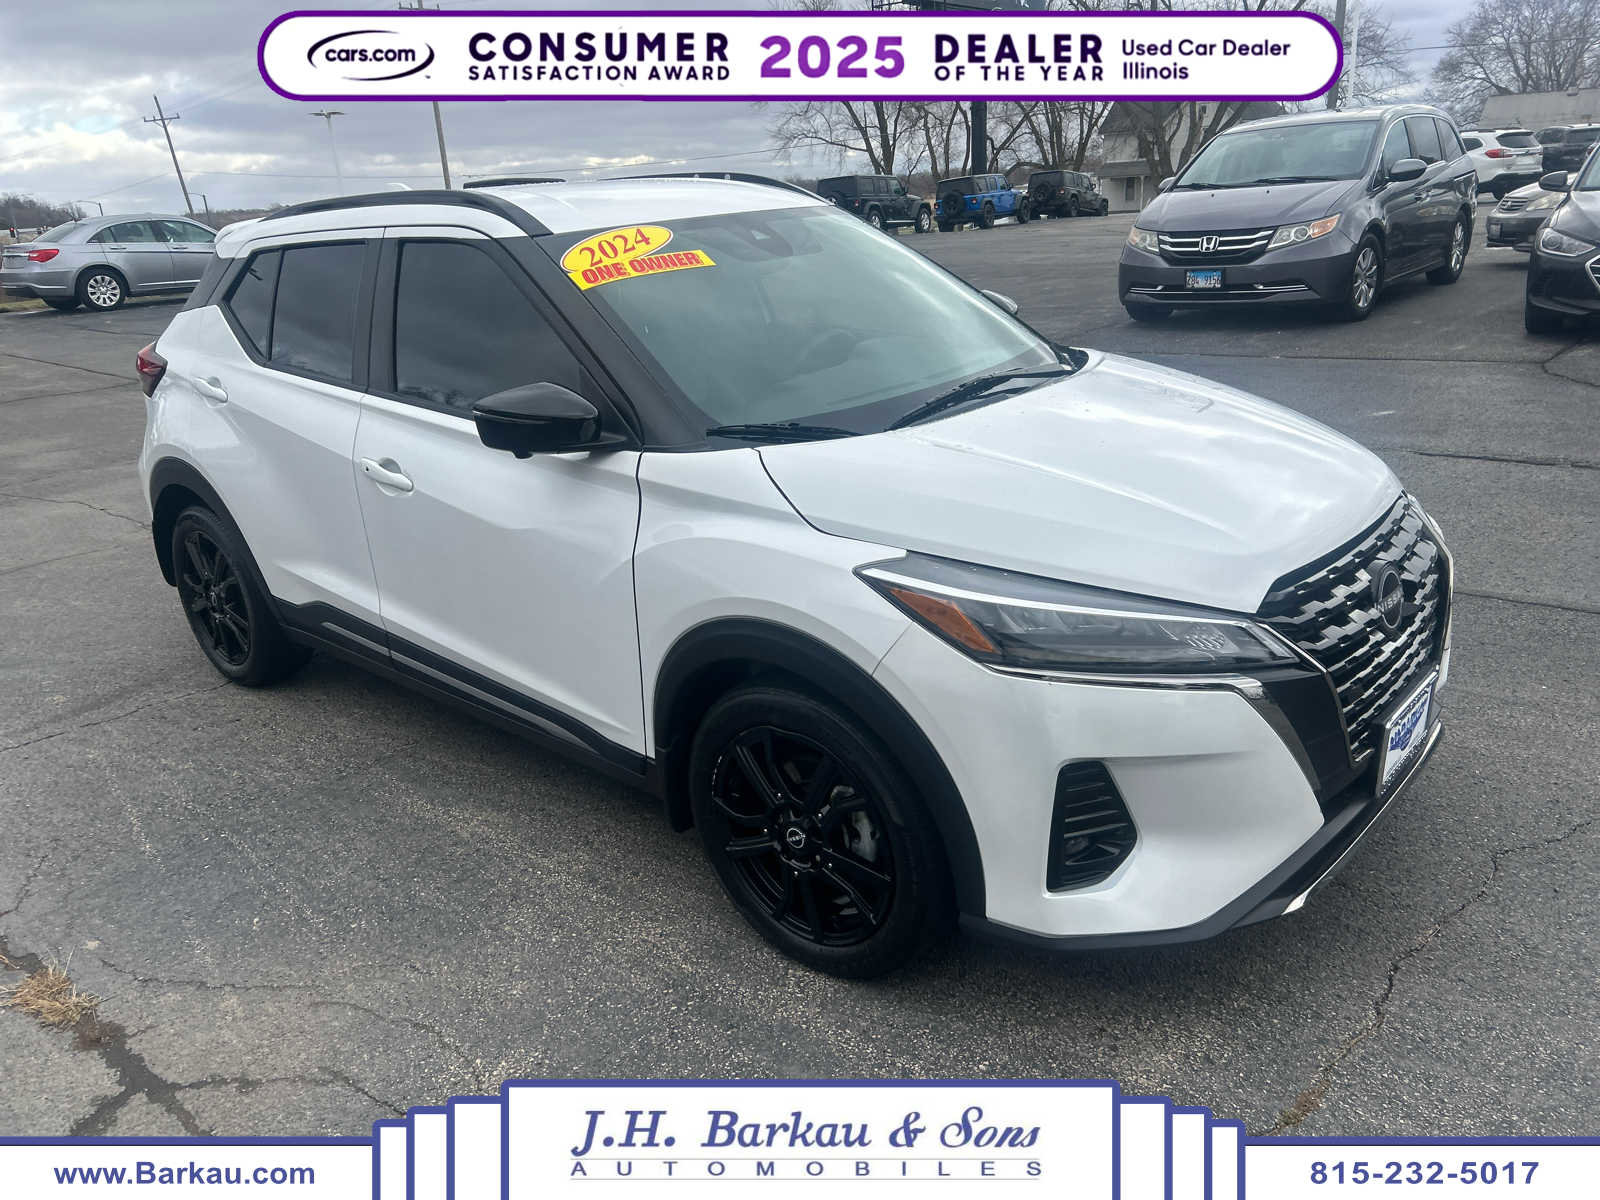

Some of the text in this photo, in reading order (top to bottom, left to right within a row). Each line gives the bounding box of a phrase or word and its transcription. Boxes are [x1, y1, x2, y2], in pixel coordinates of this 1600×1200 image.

[579, 228, 651, 267] 2024
[581, 252, 703, 284] ONE OWNER
